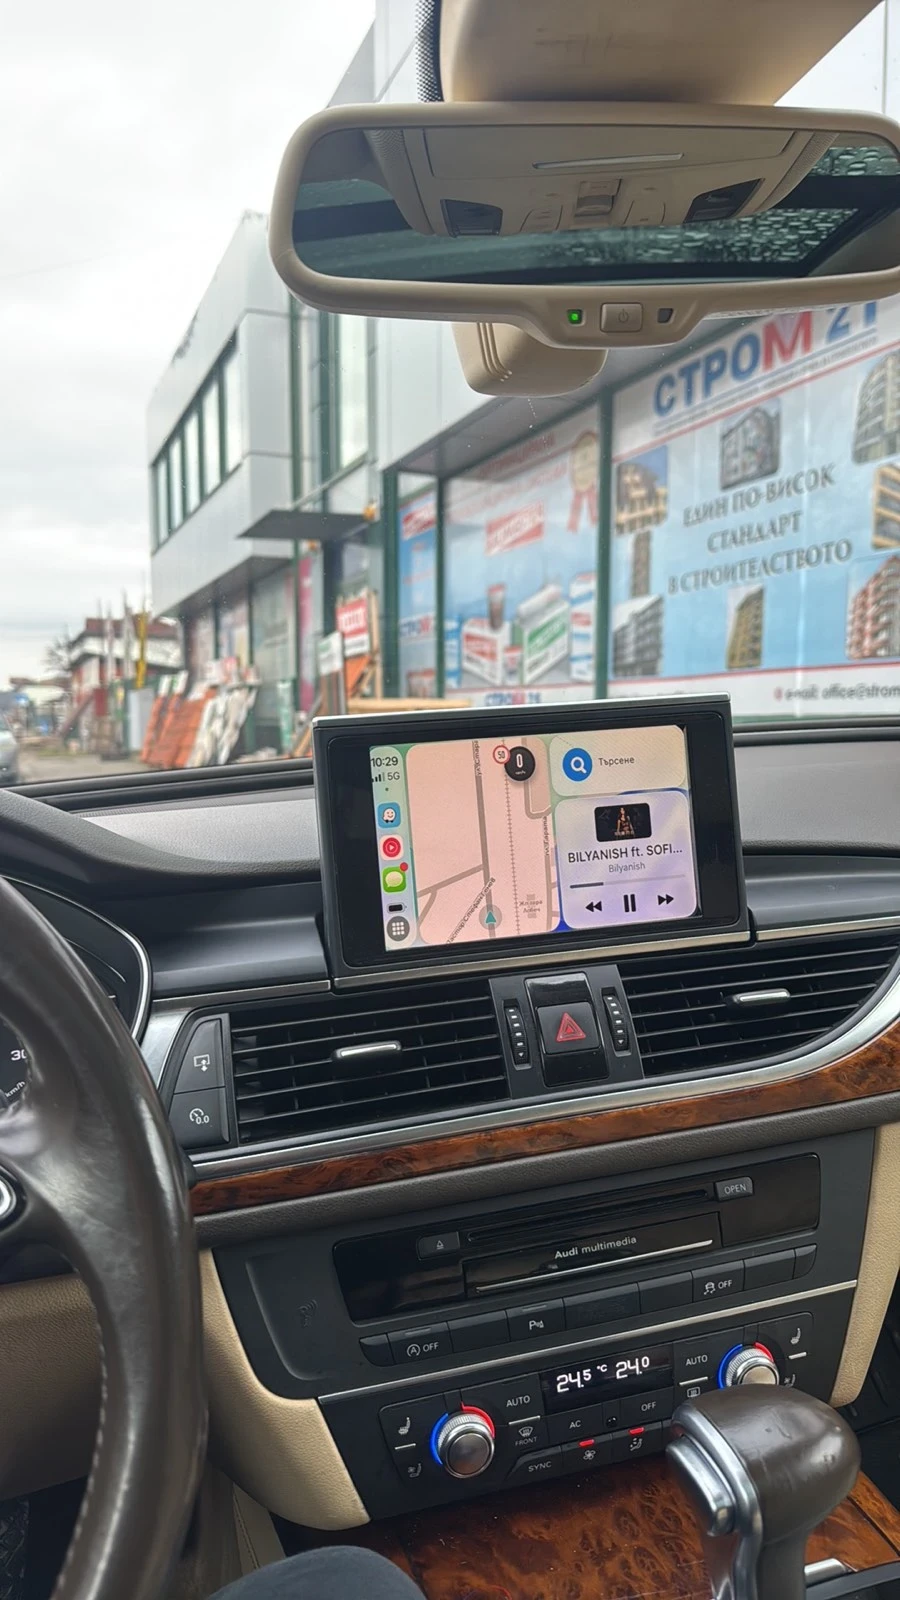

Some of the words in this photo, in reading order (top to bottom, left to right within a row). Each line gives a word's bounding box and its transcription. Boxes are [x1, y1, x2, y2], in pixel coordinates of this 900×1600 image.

[654, 311, 813, 417] СТРОМ
[682, 496, 729, 528] ЕДИН
[732, 463, 836, 514] ПО-ВИСОК
[707, 510, 803, 553] СТАНДАРТ
[667, 576, 679, 595] В
[680, 538, 854, 593] СТРОИТЕЛСТВОТО
[371, 756, 399, 768] 10:29
[516, 753, 523, 768] 0
[598, 756, 635, 767] Търсене
[387, 772, 400, 781] 5G
[568, 847, 628, 863] BILYANISH
[631, 846, 643, 858] ft.
[608, 862, 646, 874] Bilyanish
[724, 1184, 747, 1195] OPEN
[554, 1247, 578, 1259] Audi
[581, 1236, 637, 1254] multimedia
[718, 1280, 733, 1289] OFF
[423, 1342, 439, 1352] OFF
[686, 1355, 708, 1366] AUTO
[506, 1395, 531, 1408] AUTO
[641, 1402, 657, 1412] OFF
[569, 1420, 582, 1429] AC
[515, 1436, 538, 1446] FRONT
[528, 1461, 553, 1473] SYNC
